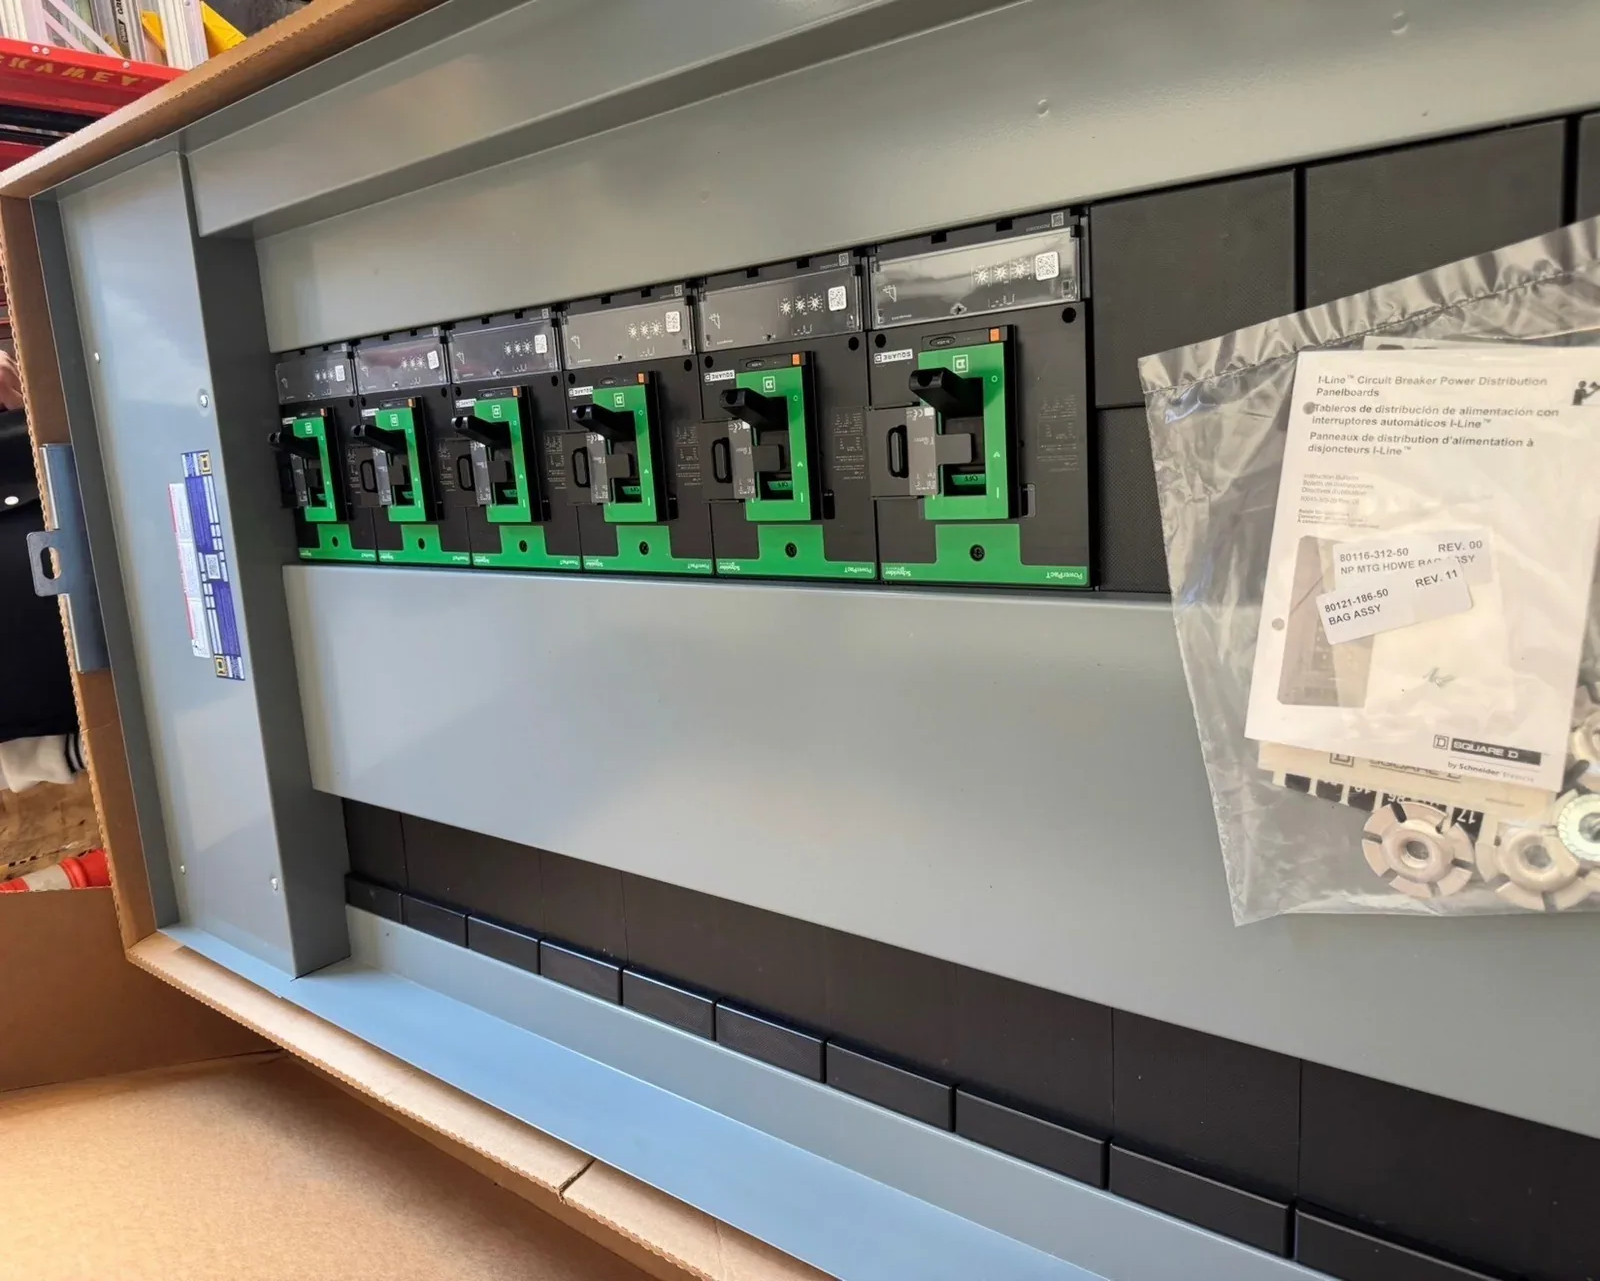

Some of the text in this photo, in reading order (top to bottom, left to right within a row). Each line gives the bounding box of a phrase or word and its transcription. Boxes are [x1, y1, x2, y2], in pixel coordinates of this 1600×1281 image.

[882, 351, 911, 361] SQUARE
[1357, 375, 1392, 385] Circuit
[1395, 376, 1437, 386] Breaker
[1440, 376, 1475, 386] Power
[1478, 376, 1548, 387] Distribution
[1316, 387, 1380, 397] Panelboards
[1314, 403, 1559, 417] Tableros de distribución de alimentación con
[1312, 416, 1378, 427] interruptores
[1380, 417, 1447, 428] automáticos
[1309, 431, 1534, 448] Panneaux de distribution d'alimentation à
[1307, 444, 1370, 455] disjoncteurs
[1339, 539, 1483, 563] 80116-312-50 REV. 00
[1340, 564, 1355, 575] NP
[1357, 563, 1380, 574] MTG
[1382, 560, 1415, 572] HDWE
[1324, 569, 1458, 613] 80121-186-50 REV. 11
[1328, 603, 1382, 626] BAG ASSY
[1453, 741, 1504, 757] SQUARE
[1507, 750, 1519, 759] D
[1447, 760, 1457, 770] by
[1459, 763, 1500, 776] Schneider
[1456, 808, 1476, 824] 17
